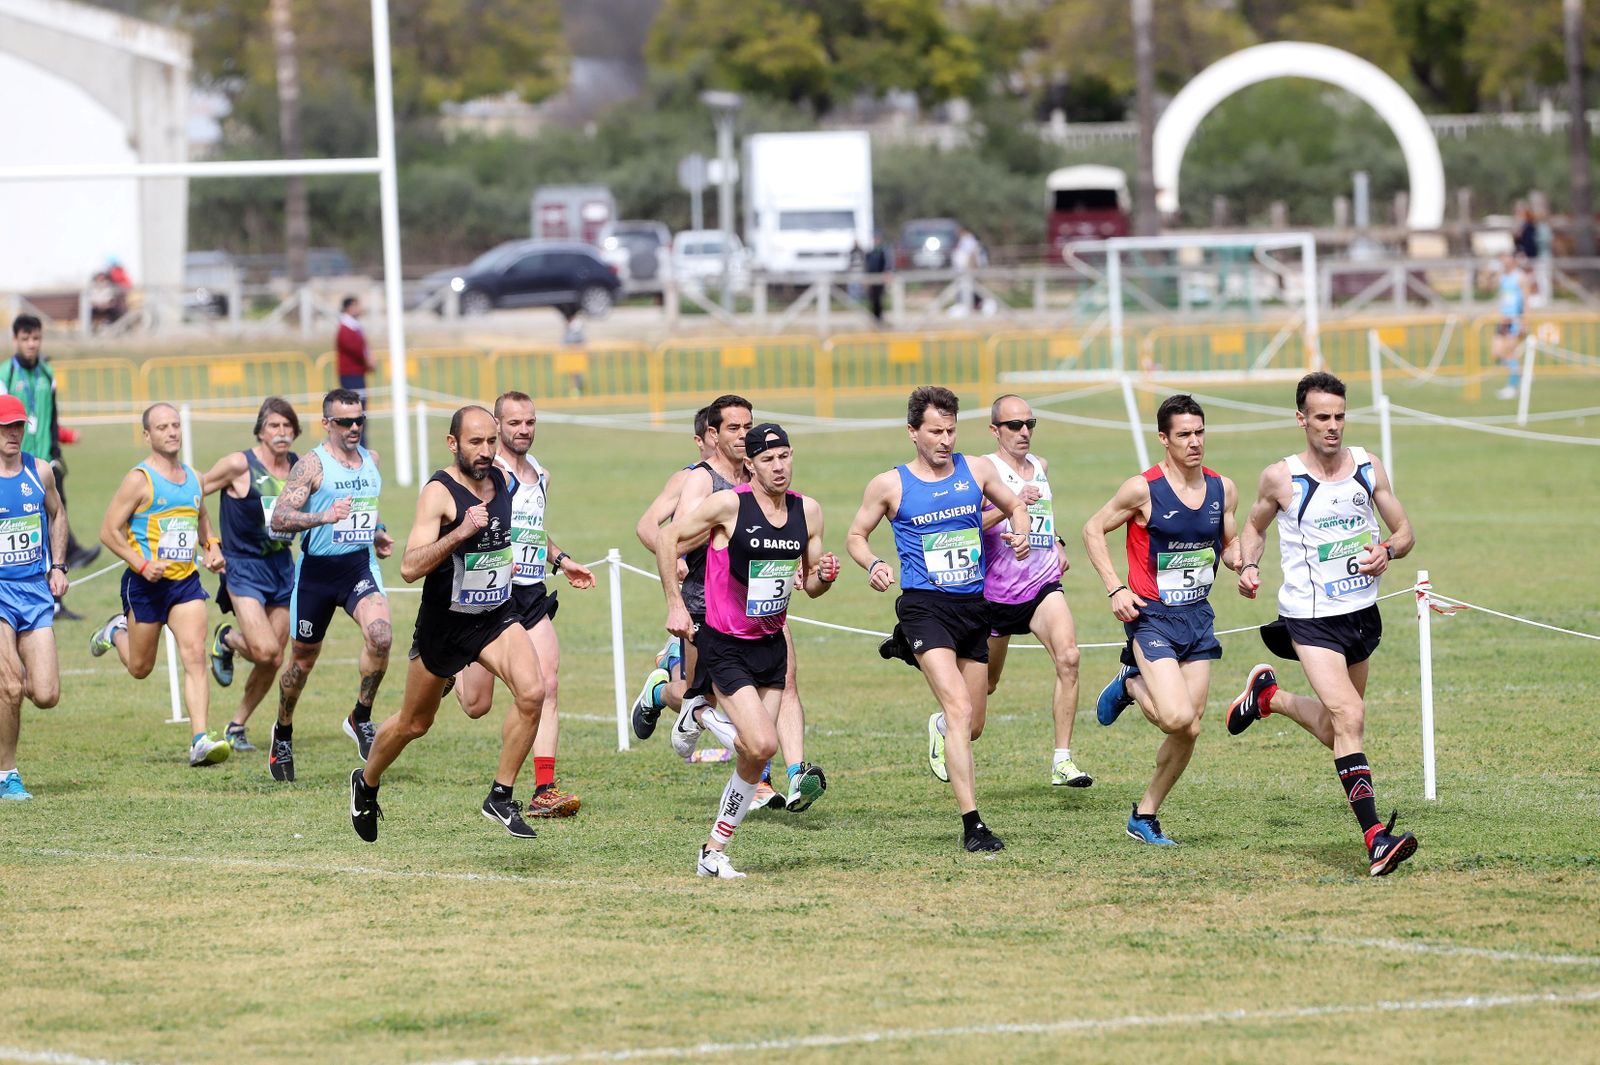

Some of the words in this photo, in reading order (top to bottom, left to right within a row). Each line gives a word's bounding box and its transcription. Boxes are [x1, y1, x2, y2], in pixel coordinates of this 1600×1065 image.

[335, 476, 369, 491] nerja
[350, 513, 371, 529] 12
[911, 504, 976, 526] TROTASIERRA
[7, 533, 30, 550] 19
[178, 532, 187, 547] 8
[750, 538, 760, 548] O
[763, 538, 800, 550] BARCO
[522, 545, 539, 563] 17
[944, 548, 970, 569] 15
[1346, 556, 1359, 575] 6
[486, 570, 498, 589] 2
[1183, 569, 1195, 588] 5
[772, 579, 785, 598] 3
